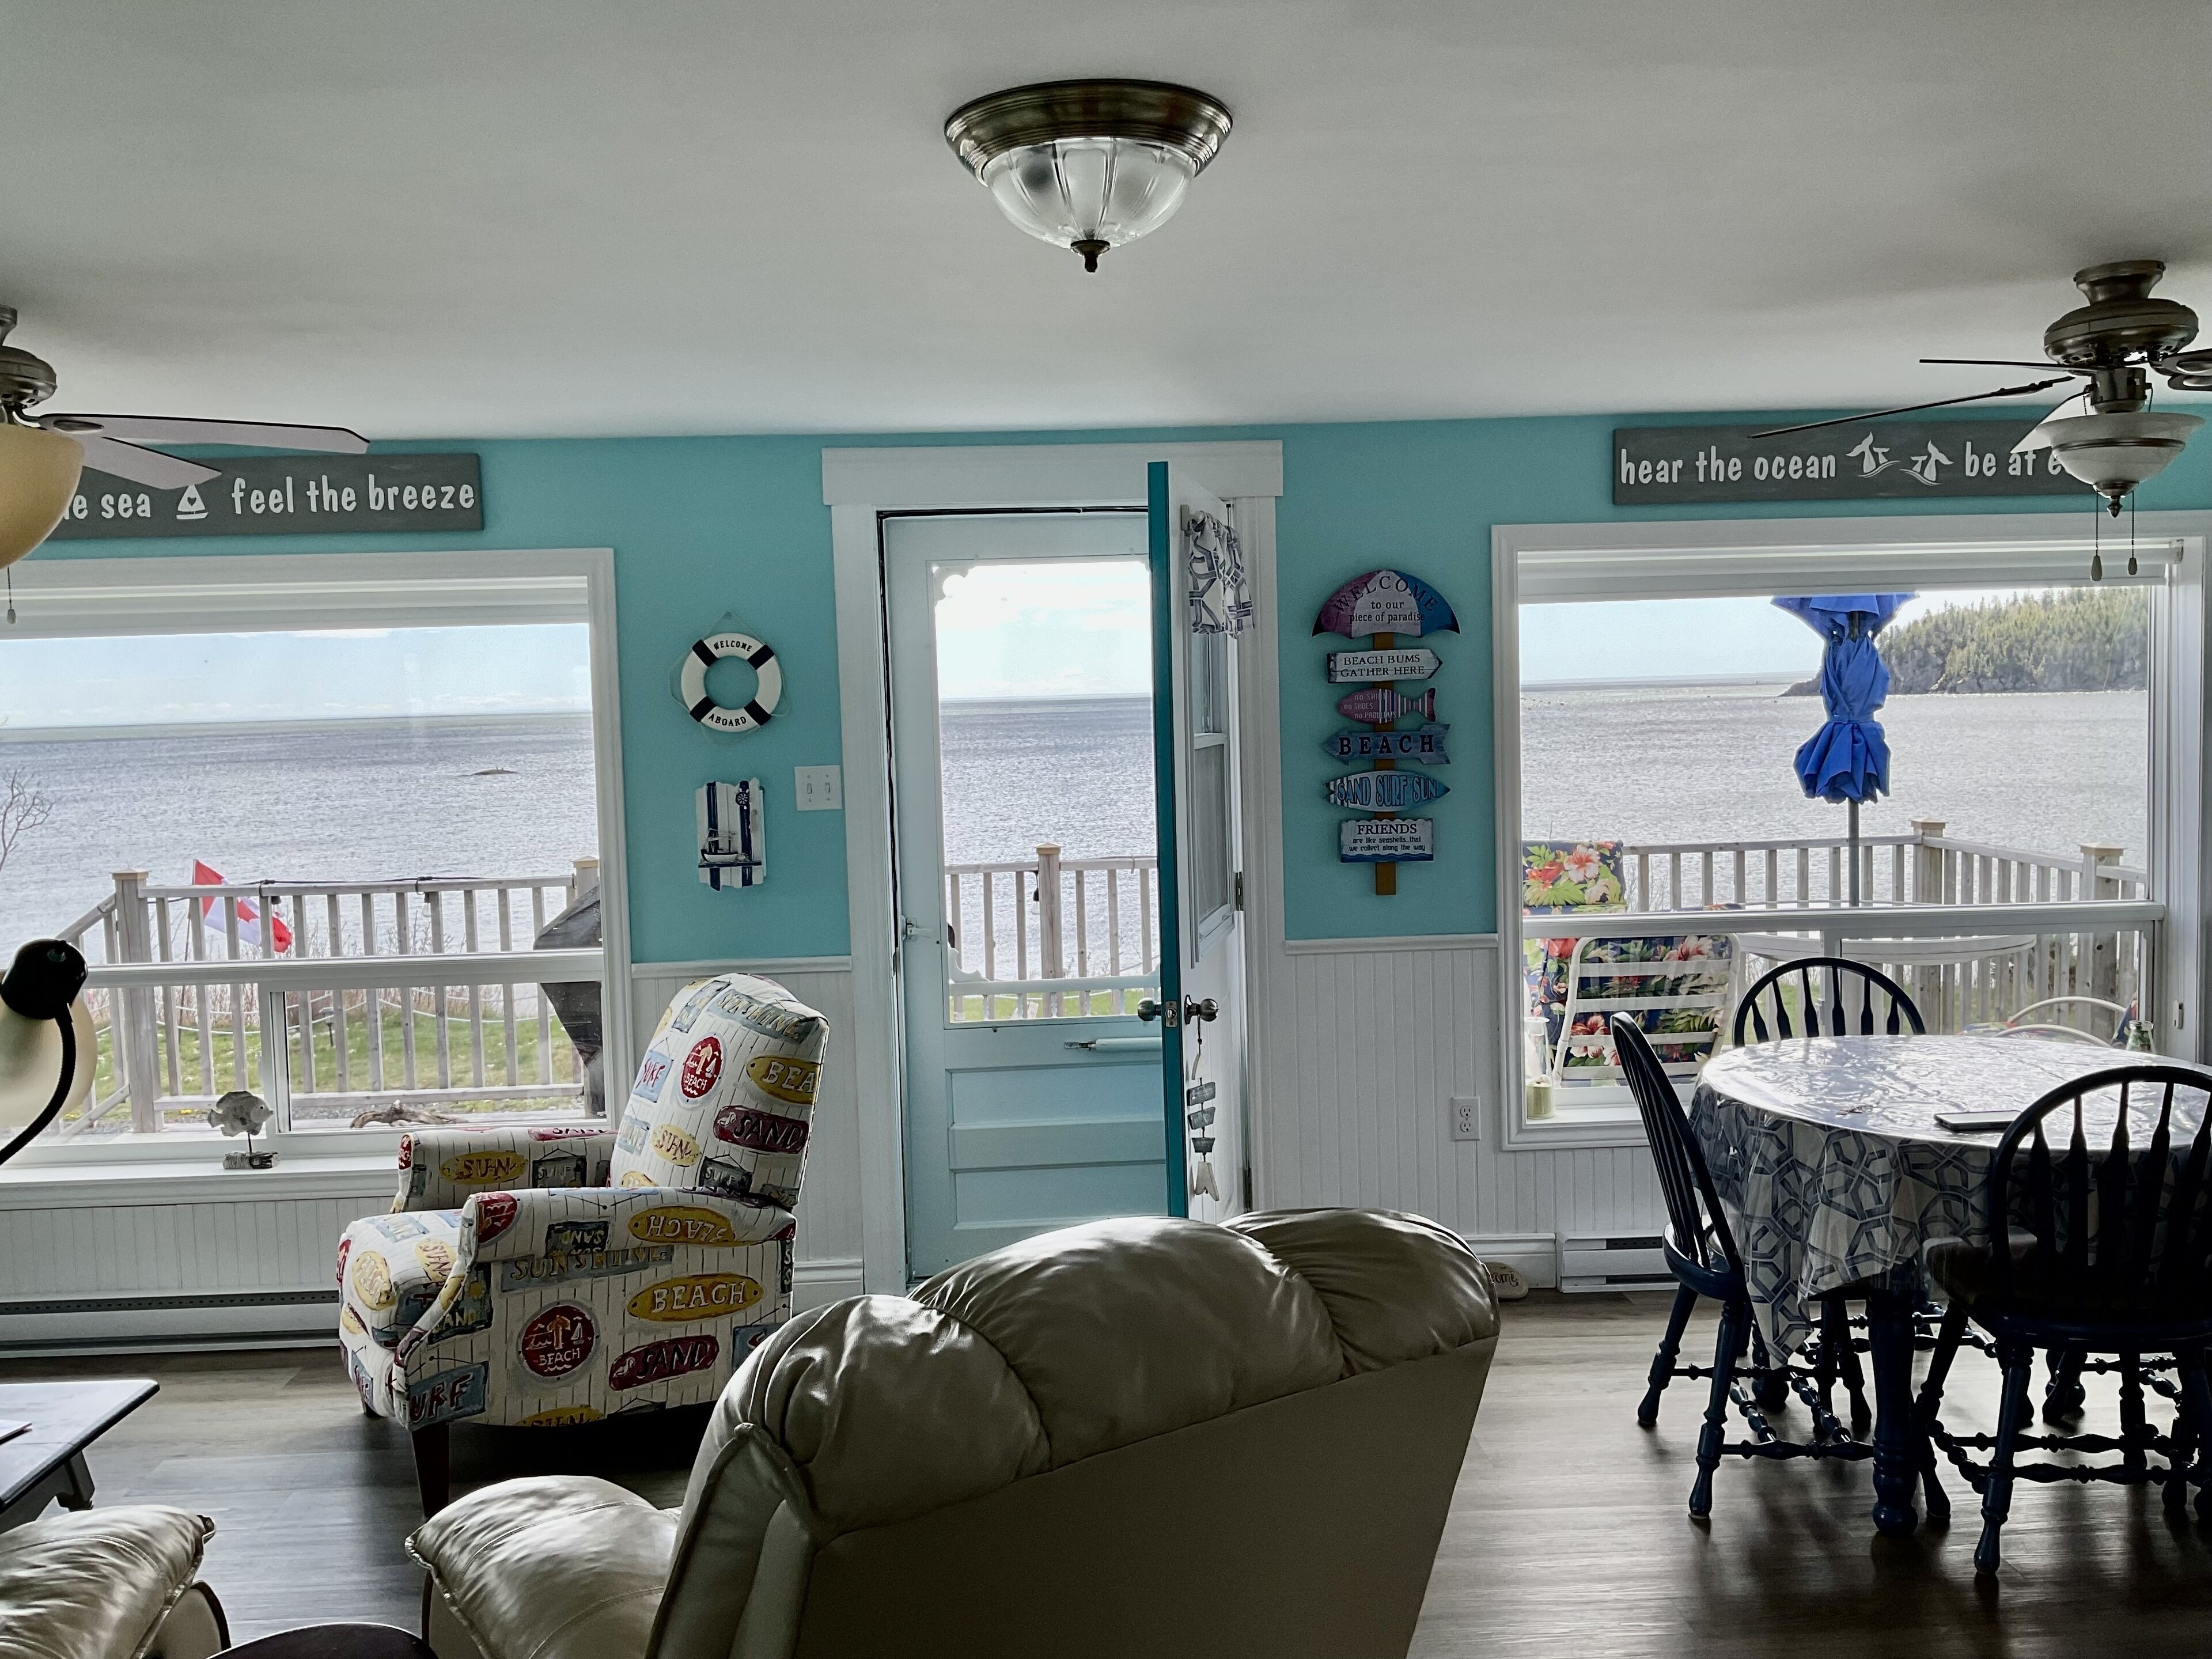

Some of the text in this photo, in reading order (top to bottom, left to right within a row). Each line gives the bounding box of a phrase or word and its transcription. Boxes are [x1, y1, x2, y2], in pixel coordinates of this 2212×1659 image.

[1620, 448, 1682, 485] hear
[1696, 445, 1742, 482] the
[1753, 452, 1836, 480] ocean
[1965, 441, 1996, 476] be
[2008, 450, 2036, 476] at
[101, 493, 151, 518] sea
[231, 476, 294, 514] feel
[306, 475, 357, 513] the
[369, 474, 475, 510] breeze
[1332, 576, 1438, 612] WELCOME
[1371, 601, 1381, 609] to
[1349, 612, 1425, 624] piece of paradise
[714, 640, 752, 652] WELCOME
[1344, 654, 1421, 665] BEACH BUMS
[1340, 666, 1425, 677] GATHER HERE
[709, 714, 747, 726] ABOARD
[1339, 734, 1434, 755] BEACH
[1337, 775, 1439, 806] SAND SURF SUN
[1357, 824, 1417, 835] FRIENDS
[684, 1073, 709, 1092] BEACH
[733, 1114, 804, 1150] SAND
[652, 1282, 747, 1313] BEACH
[539, 1348, 580, 1366] BEACH
[637, 1340, 710, 1378] SAND
[410, 1373, 473, 1423] URF
